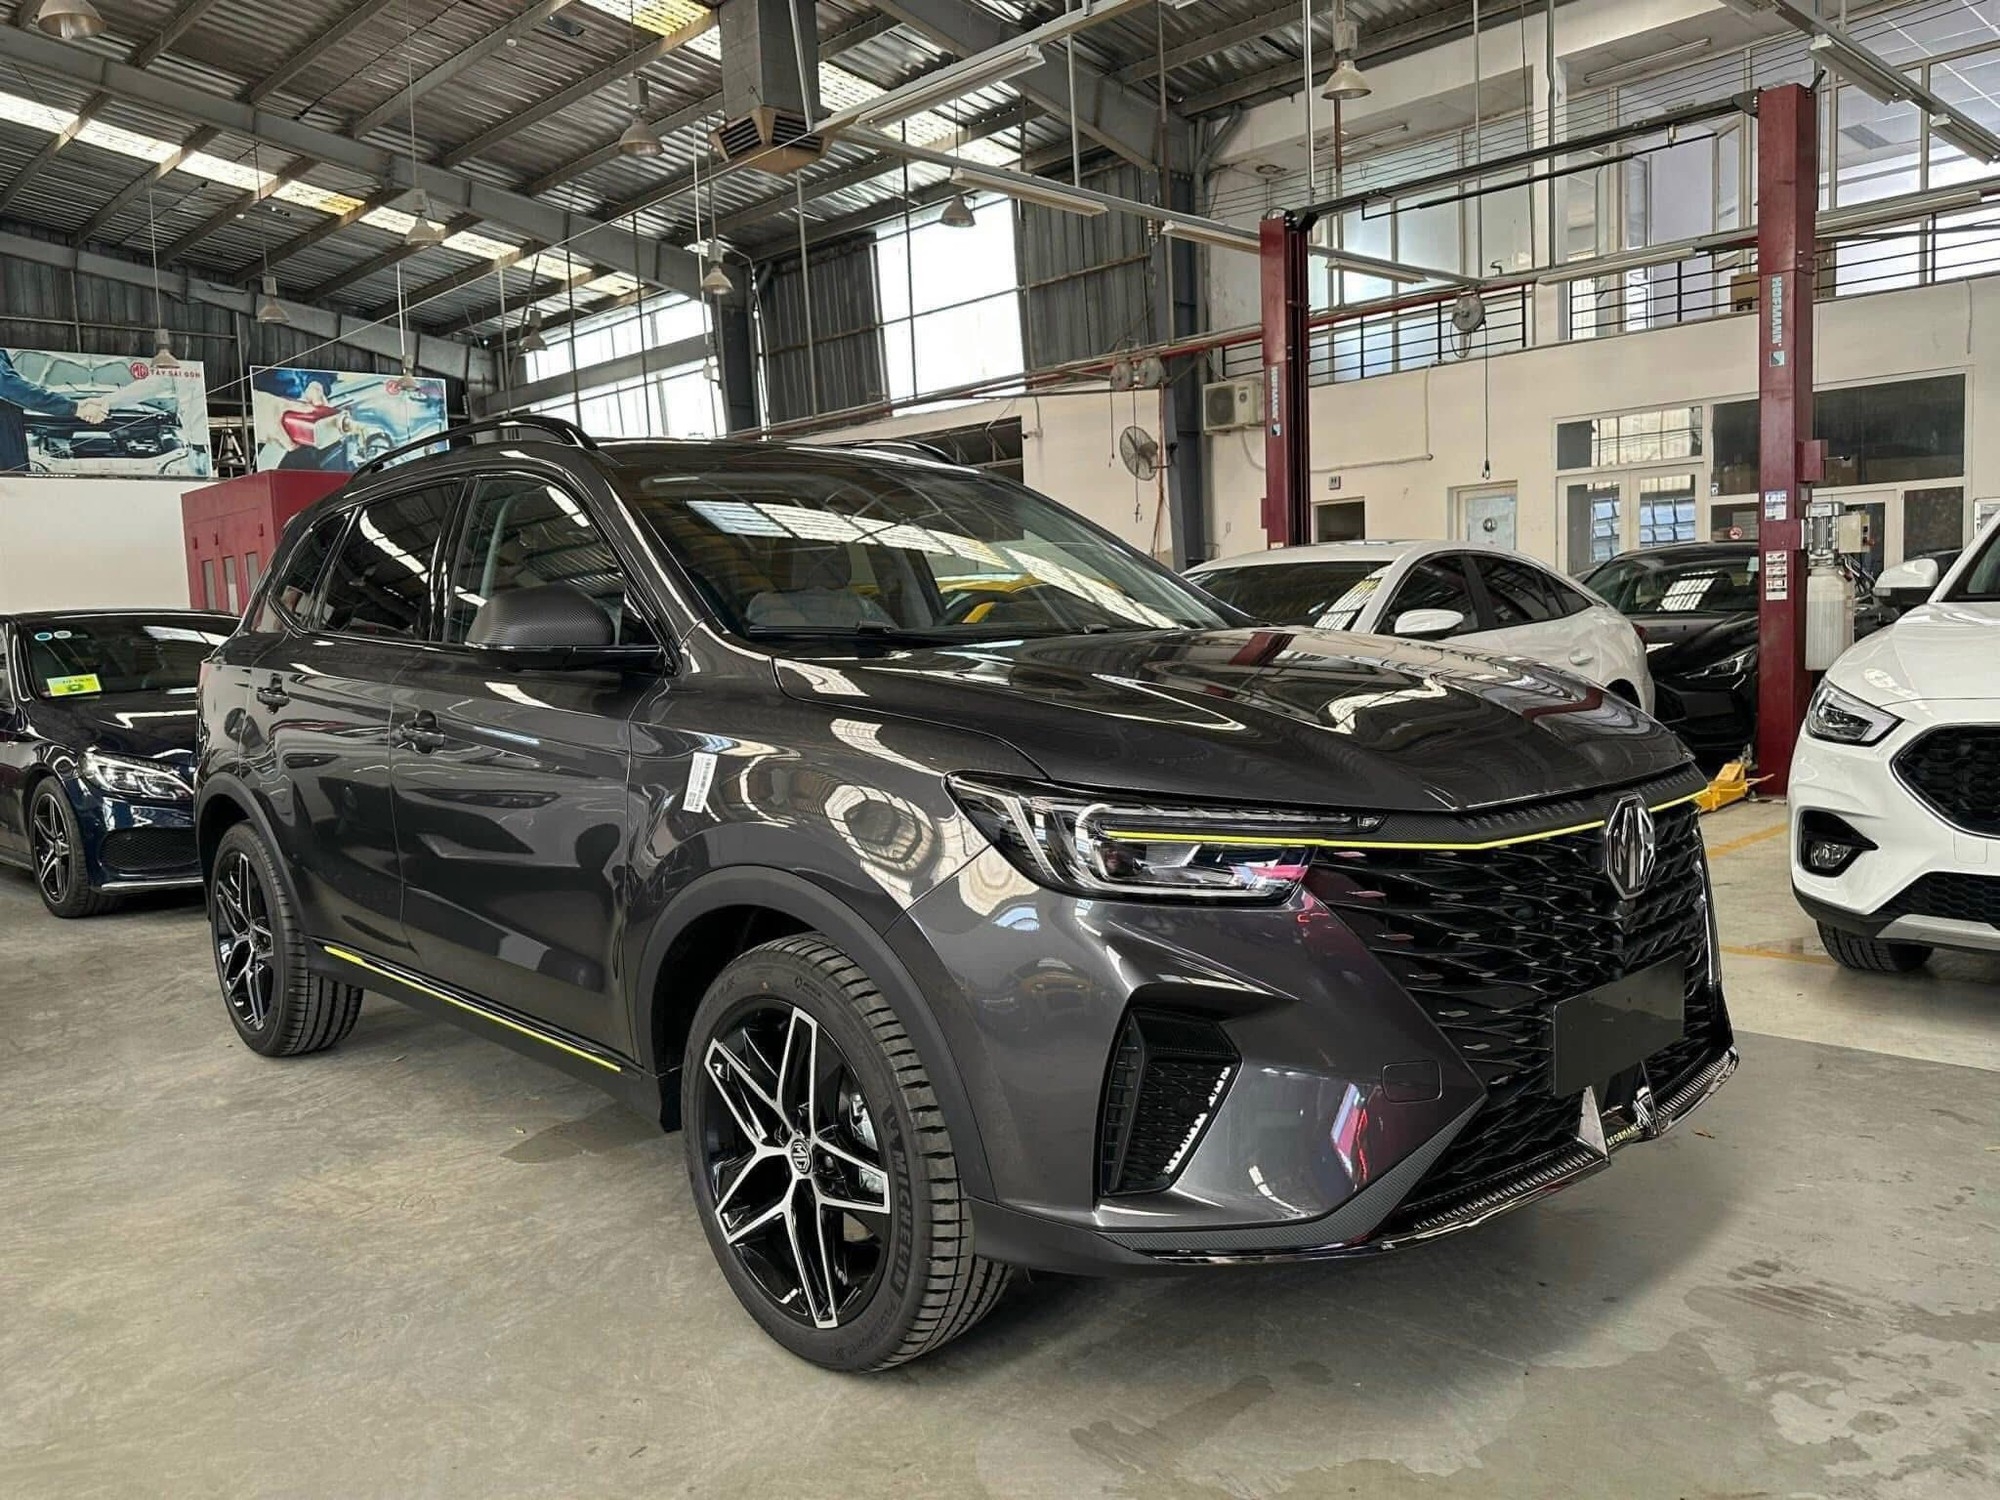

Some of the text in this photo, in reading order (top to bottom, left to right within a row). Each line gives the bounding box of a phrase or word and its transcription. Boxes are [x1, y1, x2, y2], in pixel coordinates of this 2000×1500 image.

[1771, 276, 1782, 344] HOFMANN
[1609, 798, 1655, 894] MG
[792, 1140, 809, 1172] MG
[891, 1148, 912, 1294] MICHELIN
